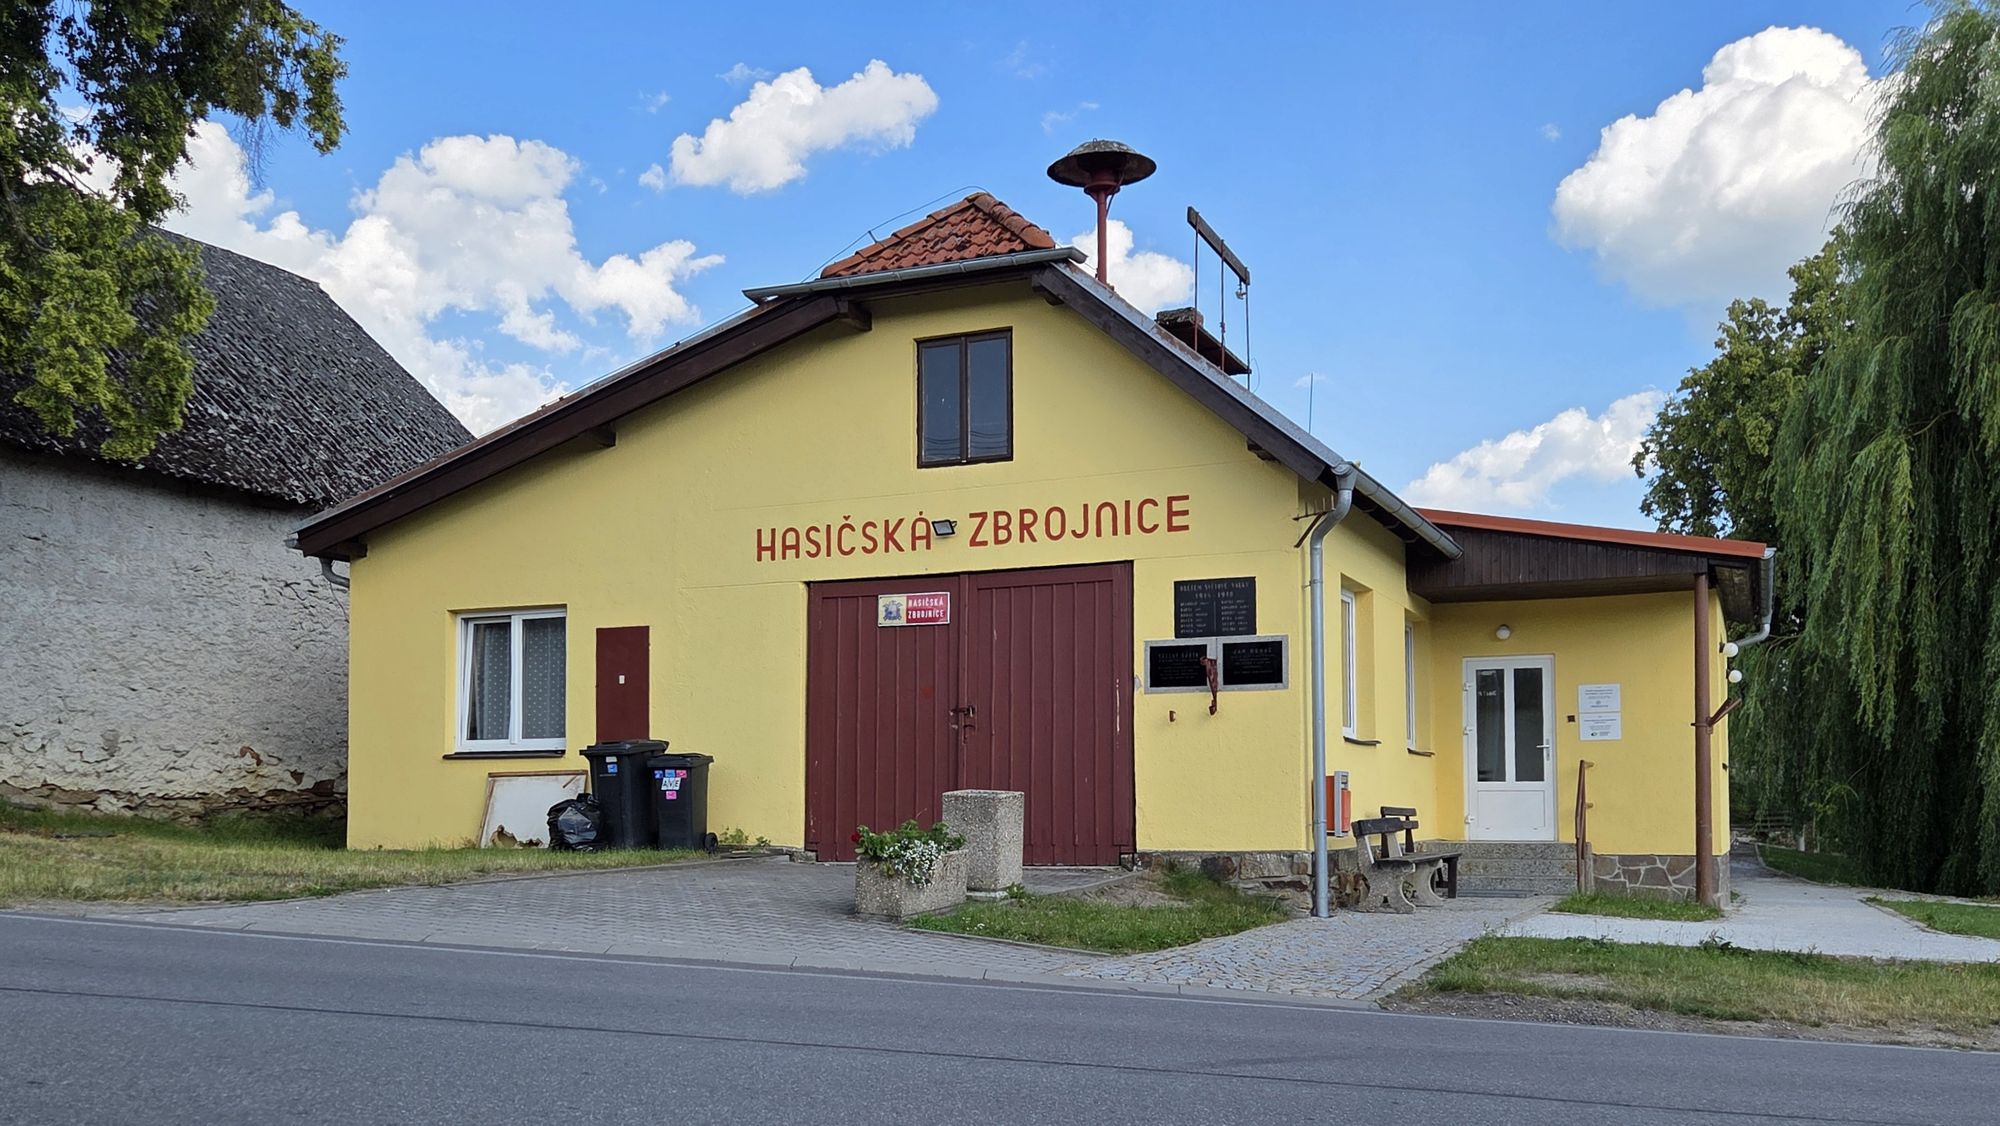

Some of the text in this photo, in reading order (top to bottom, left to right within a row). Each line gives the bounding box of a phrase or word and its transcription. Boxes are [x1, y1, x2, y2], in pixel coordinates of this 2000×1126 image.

[756, 495, 1190, 562] HASIČSKÁ ZBROJNICE
[908, 596, 944, 619] HASIČSKÁ ZBROJNICE
[663, 780, 679, 788] AVE
